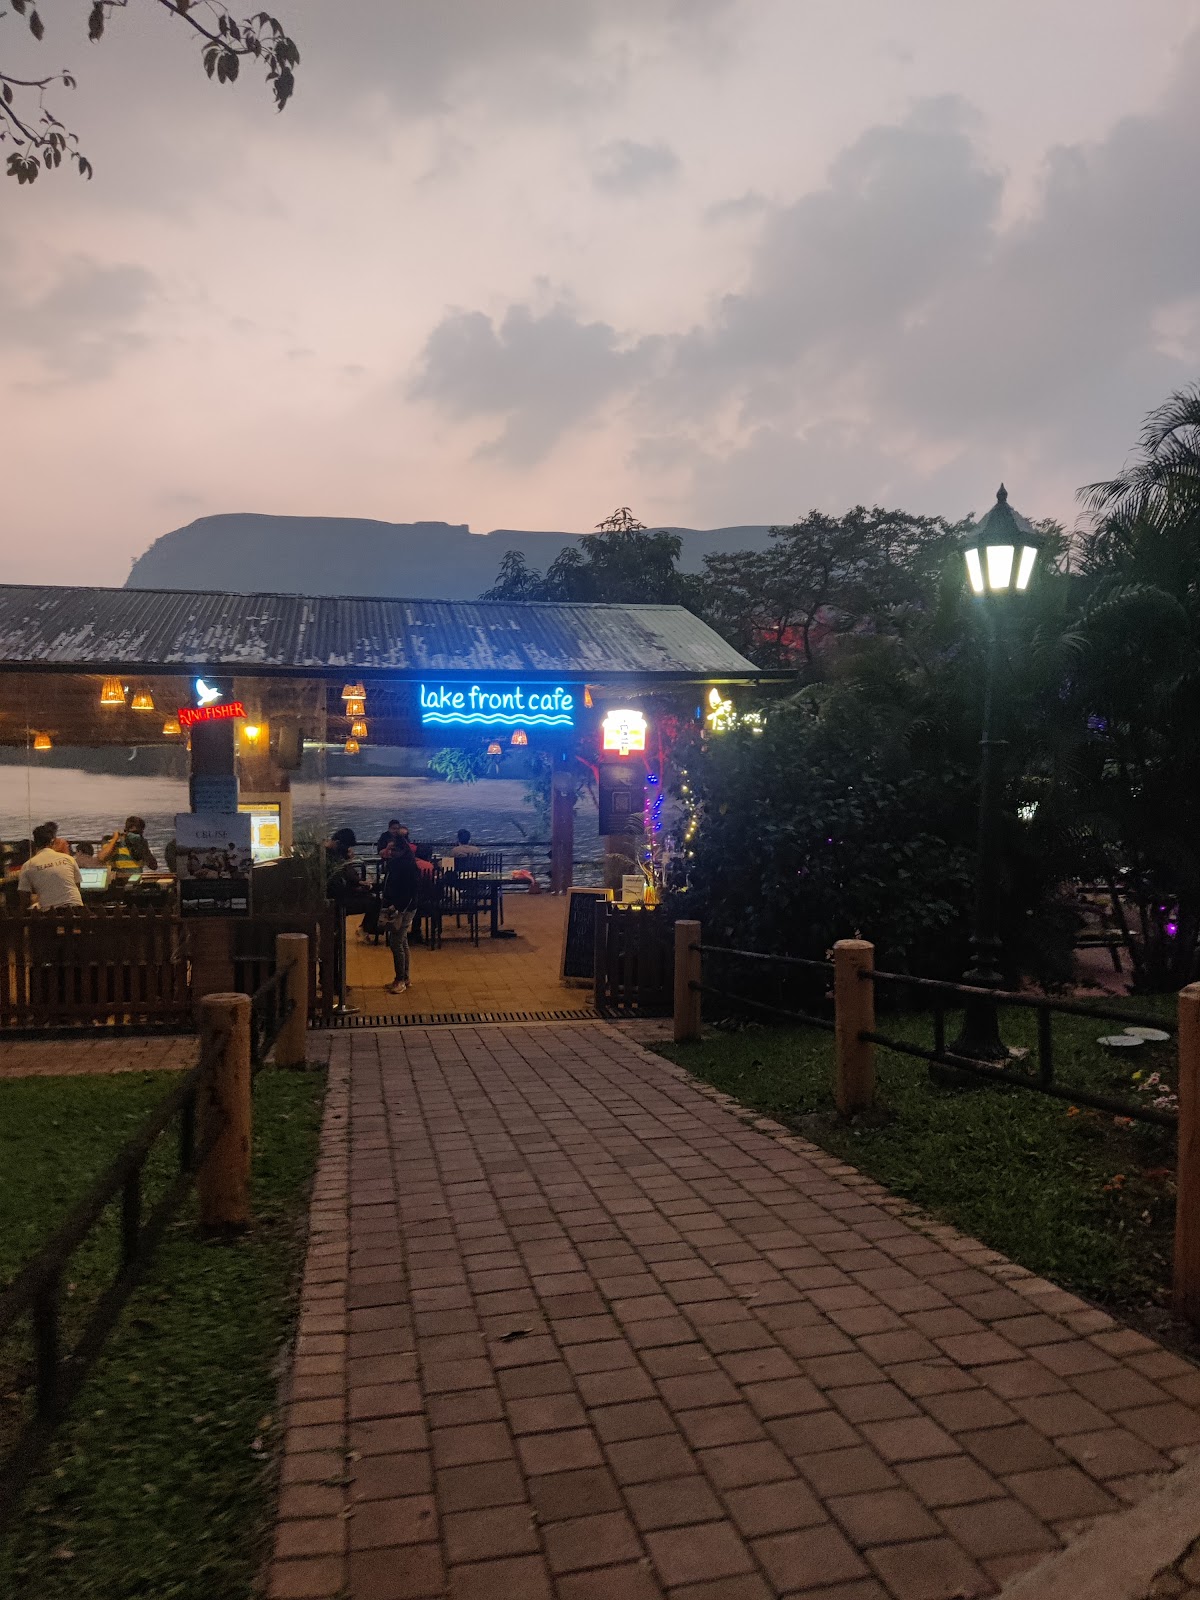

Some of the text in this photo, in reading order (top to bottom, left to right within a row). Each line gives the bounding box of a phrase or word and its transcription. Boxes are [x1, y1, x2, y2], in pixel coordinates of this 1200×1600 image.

[420, 684, 574, 711] lake front cafe
[178, 701, 247, 725] KINGFISHER
[195, 830, 228, 839] CRUISE
